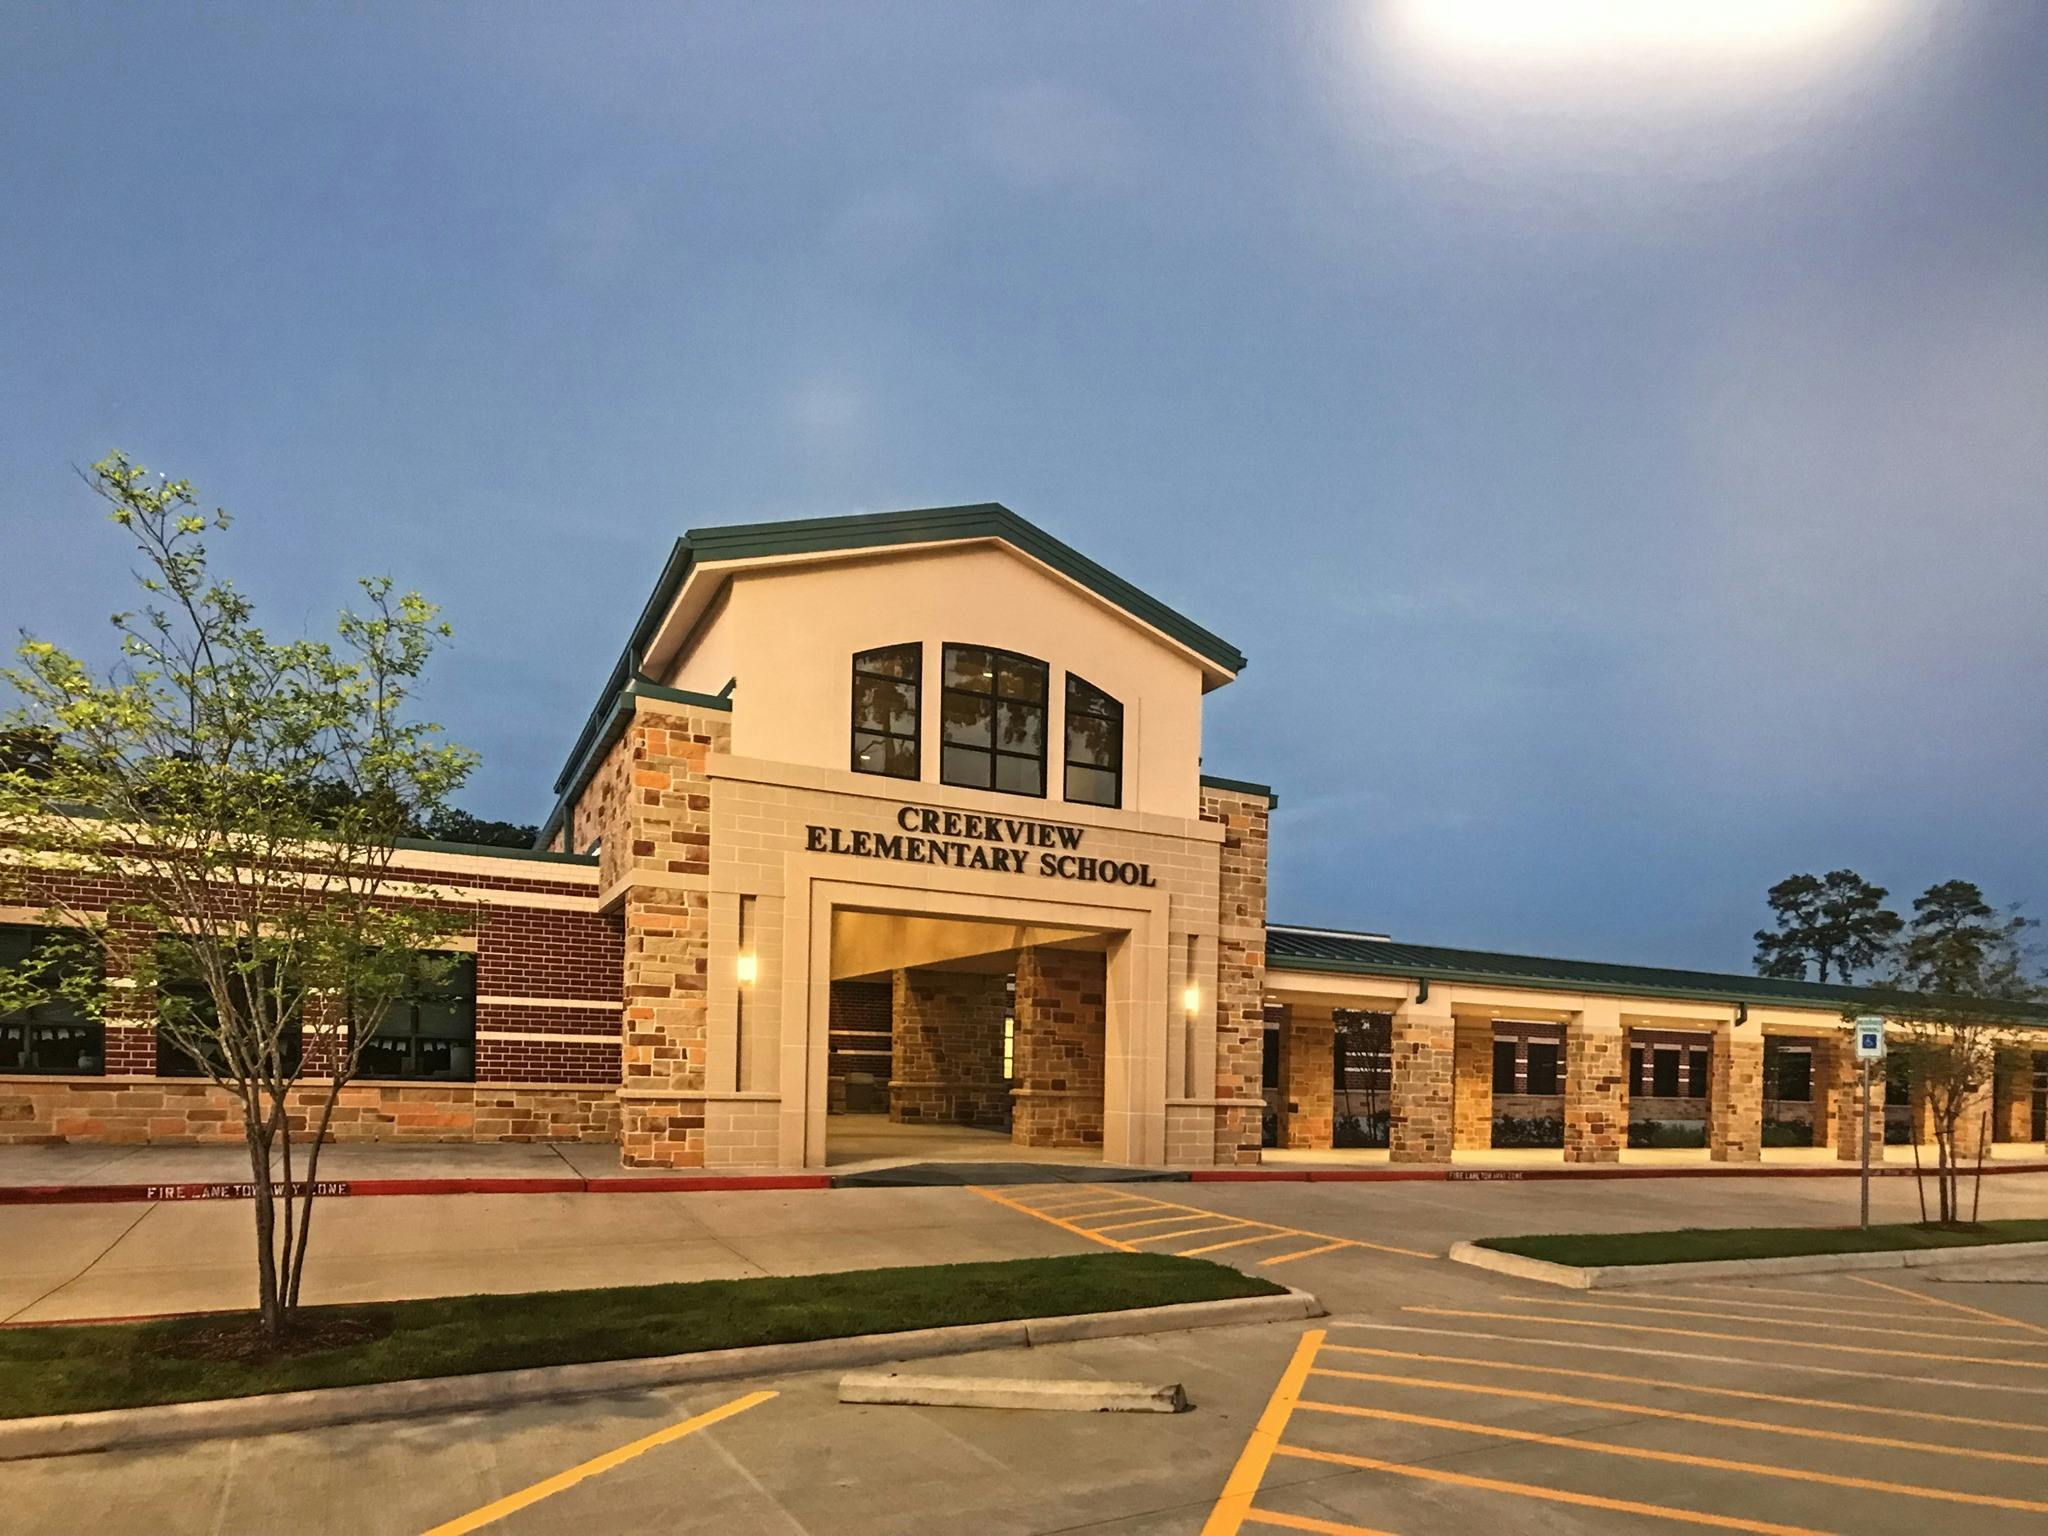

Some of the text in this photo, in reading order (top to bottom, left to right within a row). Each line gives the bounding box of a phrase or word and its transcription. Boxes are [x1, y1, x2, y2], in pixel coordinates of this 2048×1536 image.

[897, 807, 1085, 851] CREEKVIEW
[805, 825, 1157, 888] ELEMENTARY SCHOOL
[147, 1186, 185, 1199] FIRE
